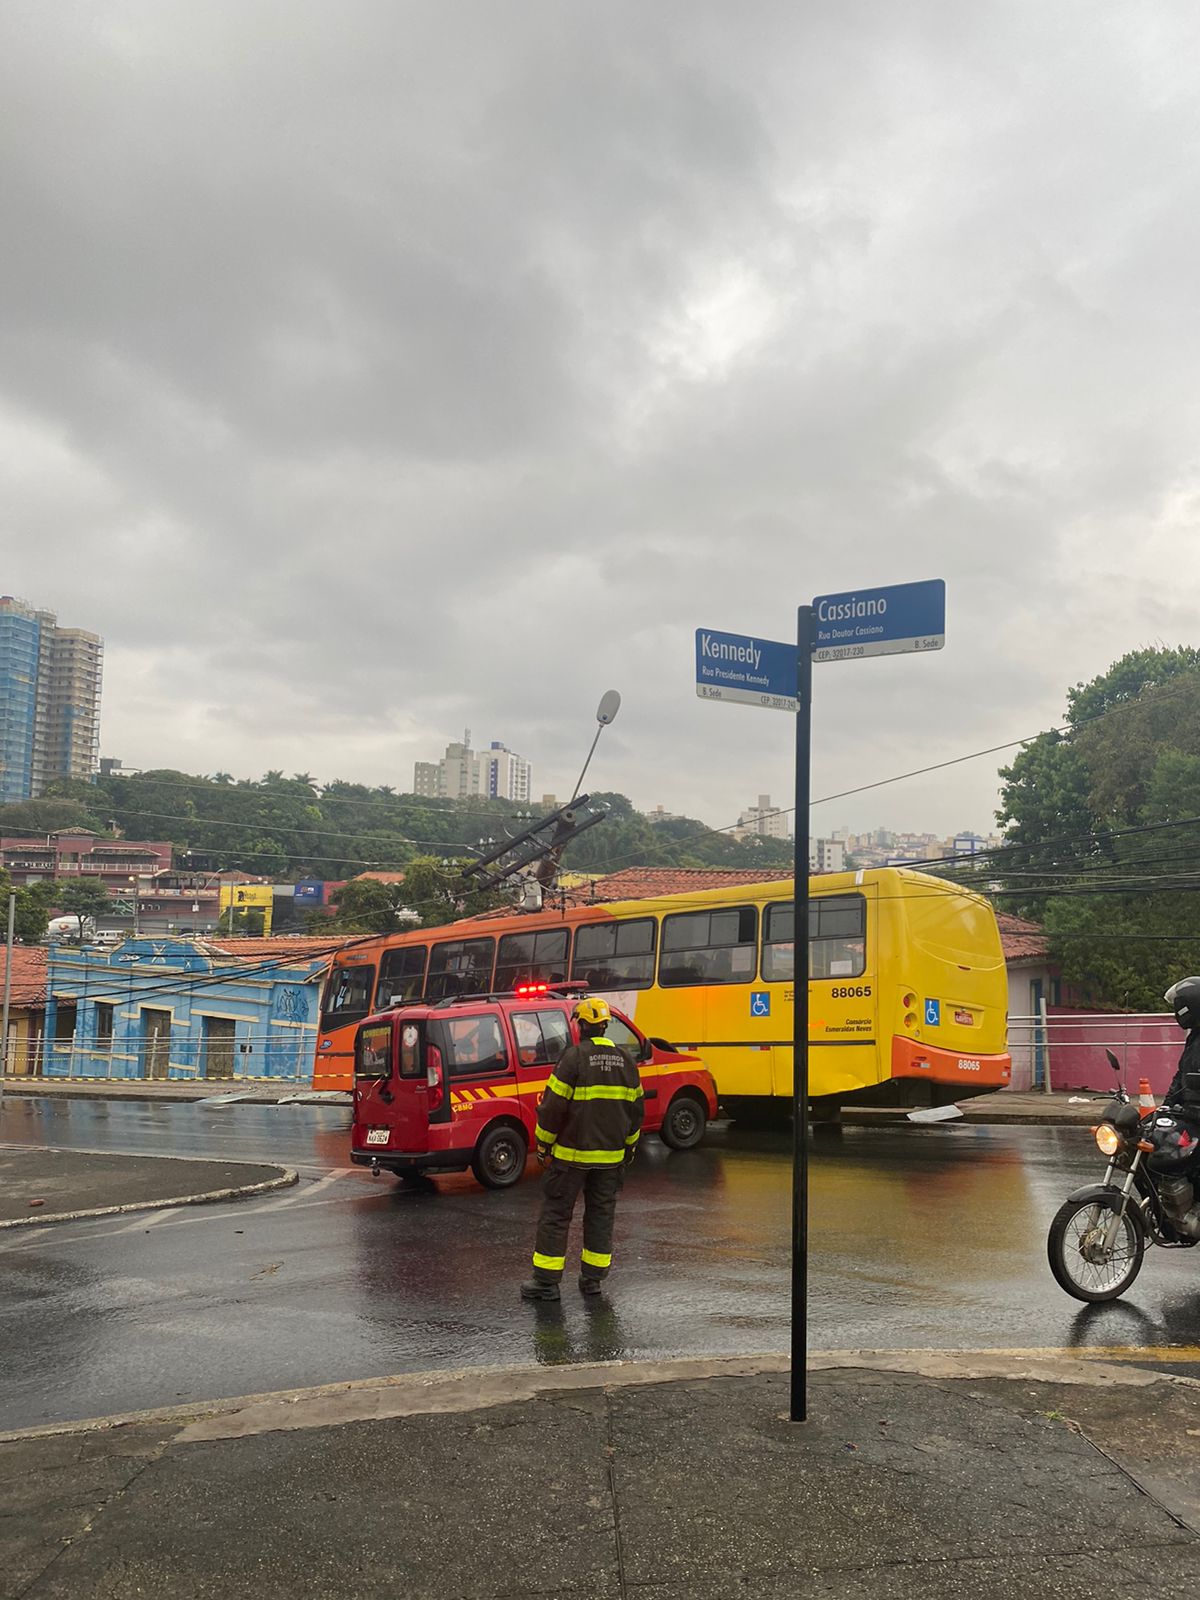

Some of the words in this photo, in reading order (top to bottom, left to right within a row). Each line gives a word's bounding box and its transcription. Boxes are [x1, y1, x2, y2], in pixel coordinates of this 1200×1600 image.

[818, 597, 887, 622] Cassiano
[818, 631, 831, 640] Rua
[832, 628, 854, 638] Doutor
[855, 625, 884, 635] Cassiano
[914, 640, 922, 649] B.
[923, 638, 939, 648] Sede
[702, 633, 761, 670] Kennedy
[818, 648, 831, 659] CEP:
[832, 646, 865, 658] 32017-230
[702, 665, 714, 677] Rua
[715, 667, 745, 682] Presidente
[746, 672, 770, 687] Kennedy
[709, 688, 722, 697] Sede
[831, 986, 872, 998] 88065
[856, 1025, 872, 1033] Neves
[589, 1054, 624, 1062] BOMBEIROS
[958, 1059, 980, 1071] 88065
